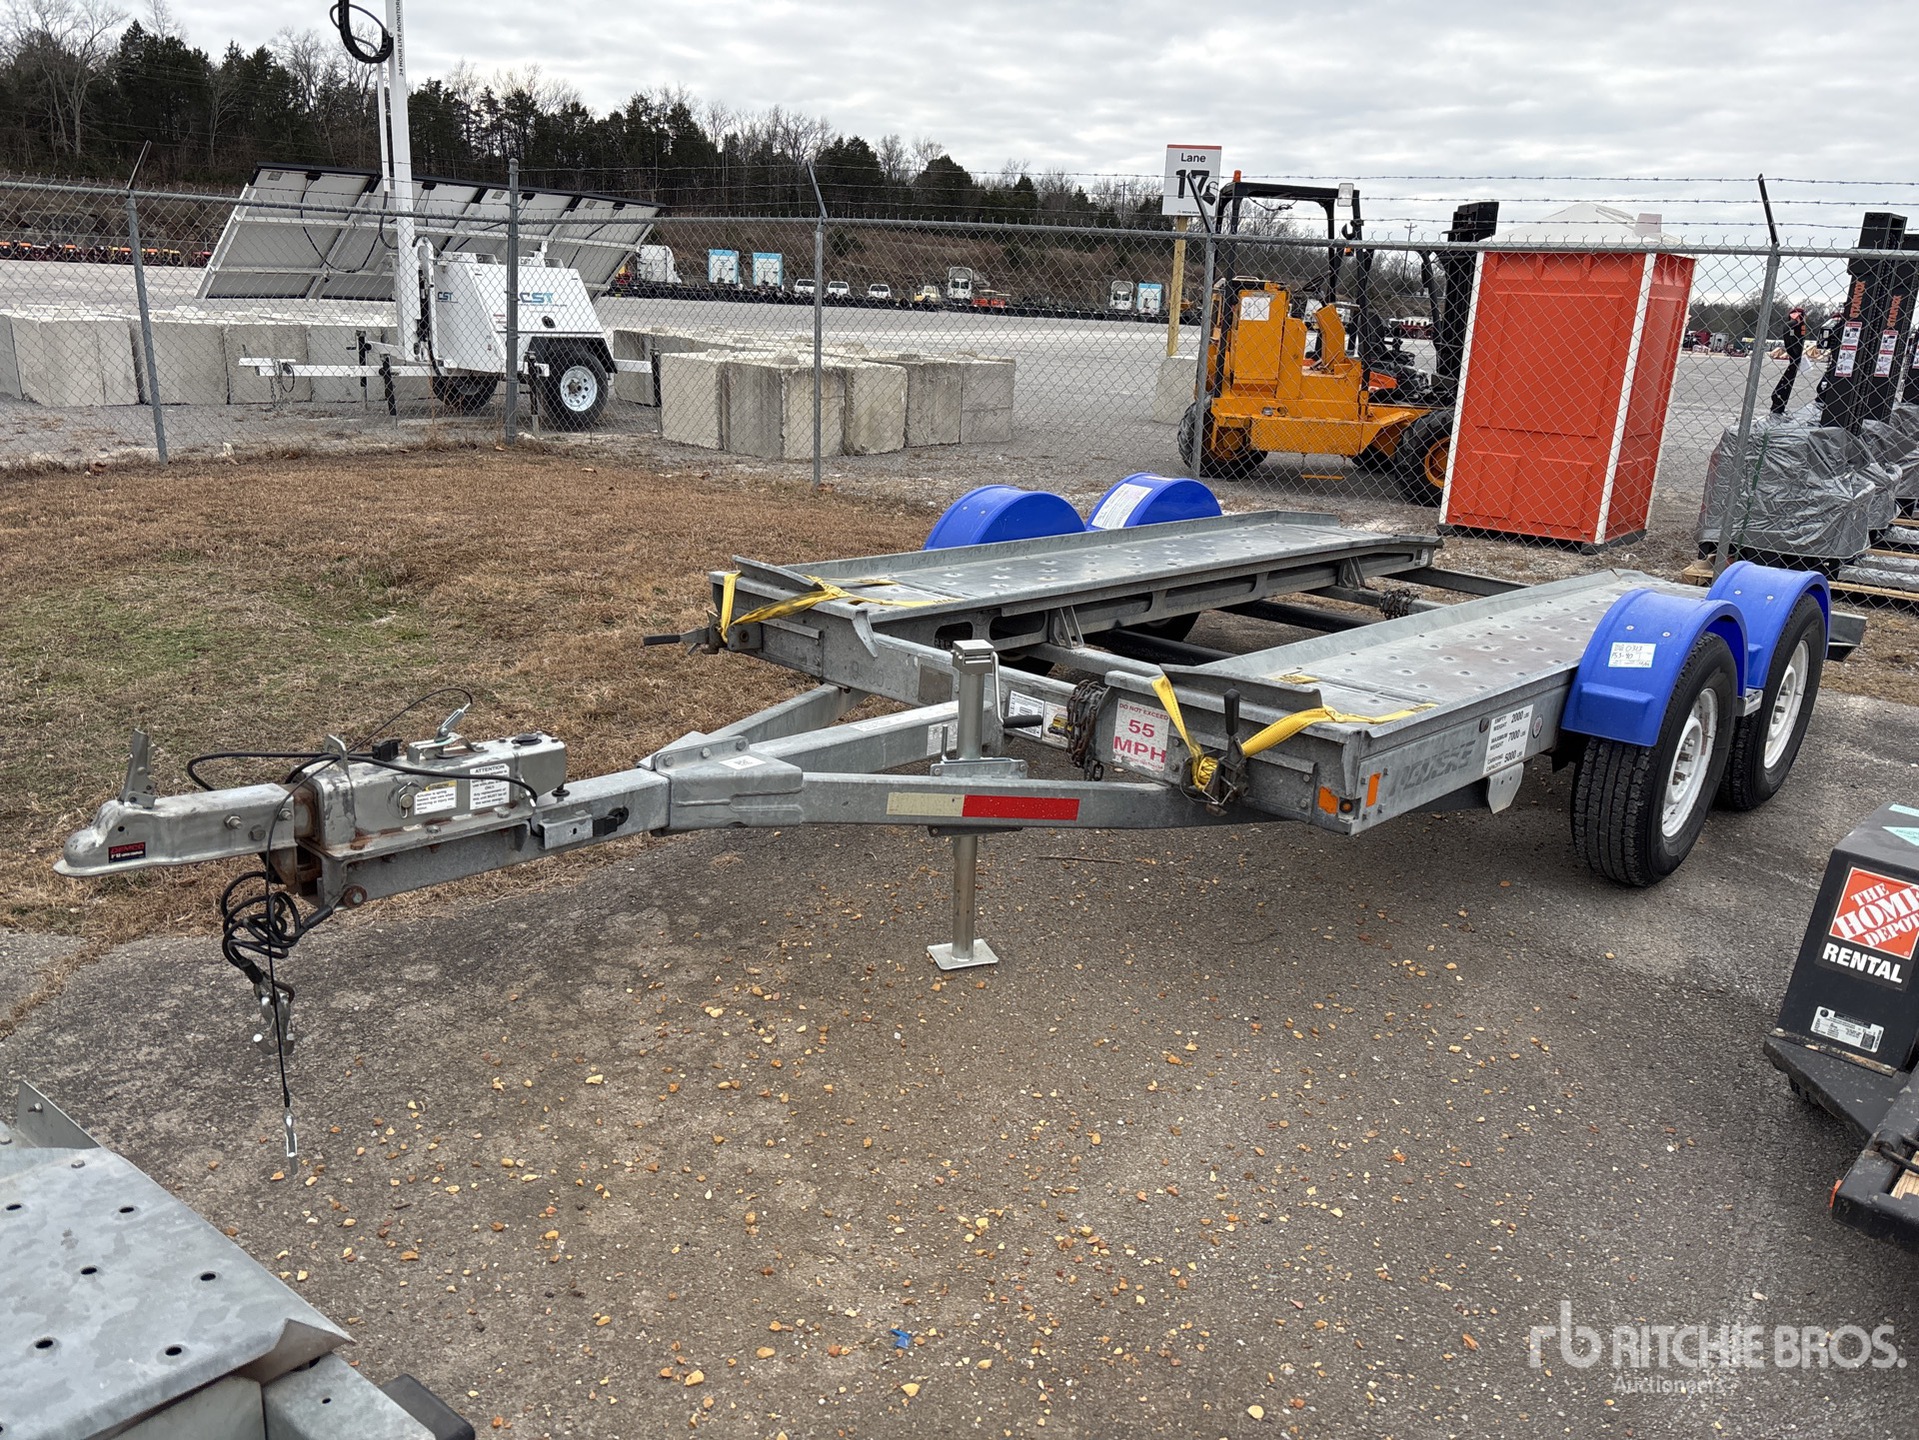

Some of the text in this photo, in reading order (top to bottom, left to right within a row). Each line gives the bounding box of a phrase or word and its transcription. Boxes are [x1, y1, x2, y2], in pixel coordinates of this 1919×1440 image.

[399, 68, 404, 76] 24
[1181, 152, 1206, 163] Lane
[1175, 169, 1210, 199] 17
[437, 291, 454, 301] CST
[519, 292, 554, 304] CST
[1119, 702, 1169, 721] DO NOT EXCEED
[1511, 710, 1524, 724] 2000
[1128, 719, 1155, 738] 55
[1493, 721, 1508, 732] WEIGHT
[1507, 729, 1521, 742] 7000
[1113, 735, 1167, 764] MPH
[1504, 750, 1517, 763] 5000
[475, 765, 505, 774] ATTENTION
[1850, 882, 1890, 907] THE
[1822, 942, 1903, 984] RENTAL
